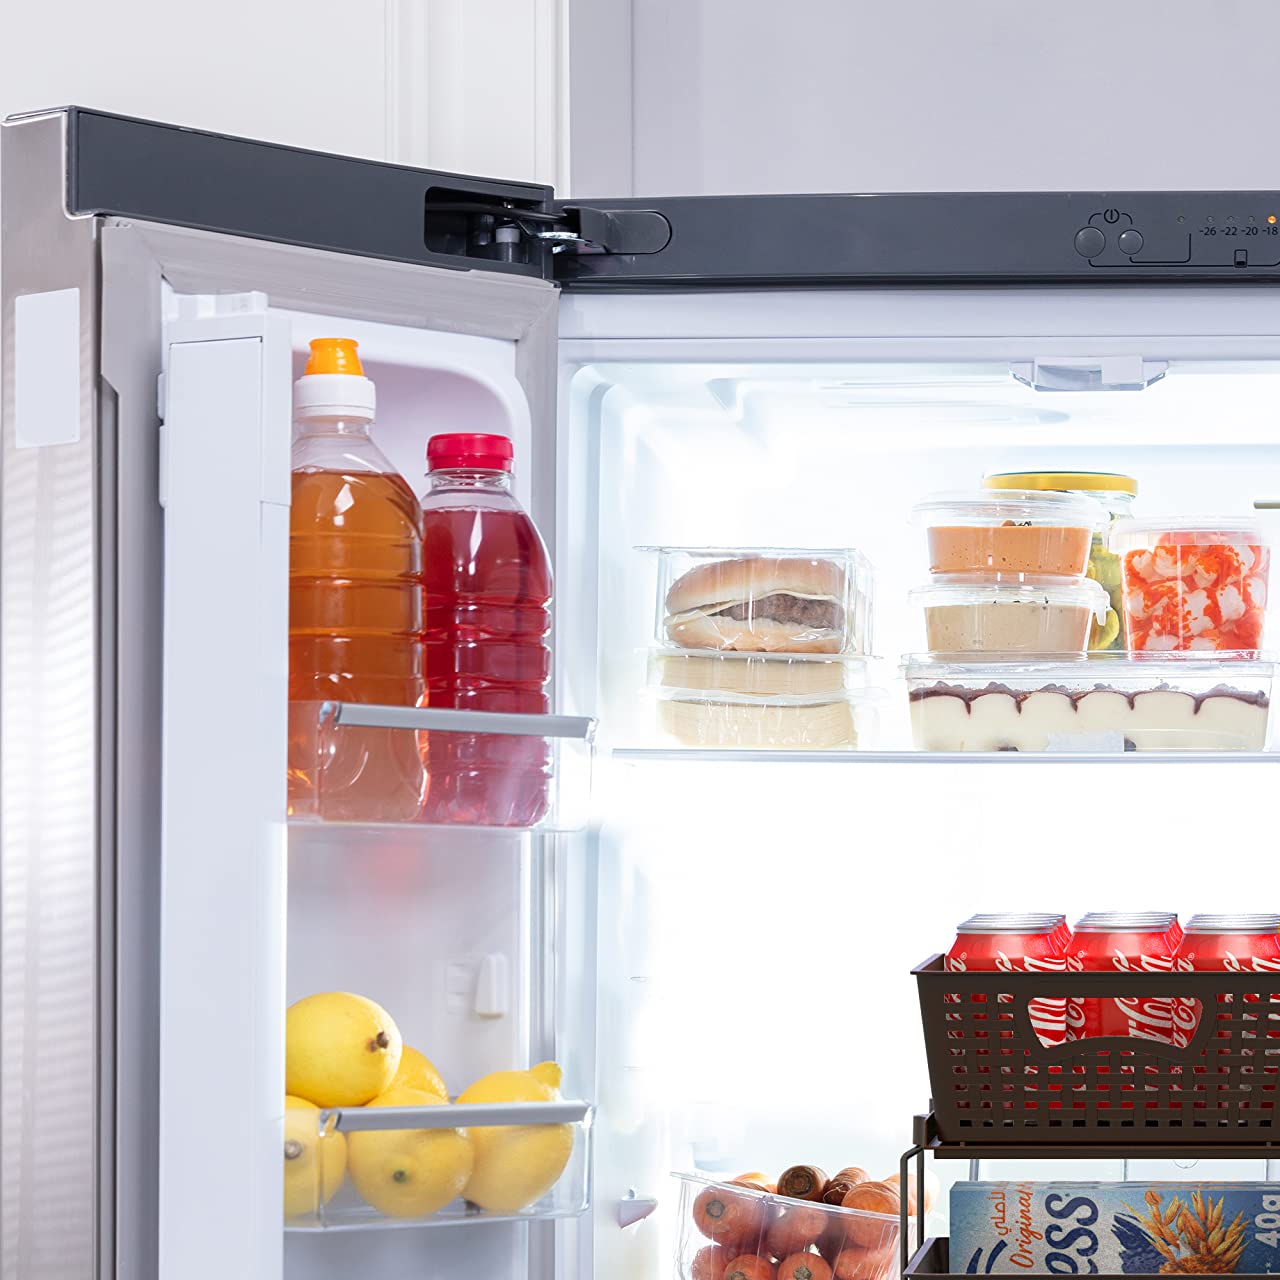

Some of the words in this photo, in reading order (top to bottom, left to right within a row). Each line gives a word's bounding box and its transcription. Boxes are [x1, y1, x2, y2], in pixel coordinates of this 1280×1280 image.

[1199, 226, 1217, 236] -26
[1220, 226, 1238, 236] -22
[1241, 226, 1258, 236] -20
[1262, 226, 1278, 236] -18
[1009, 1189, 1043, 1269] Original
